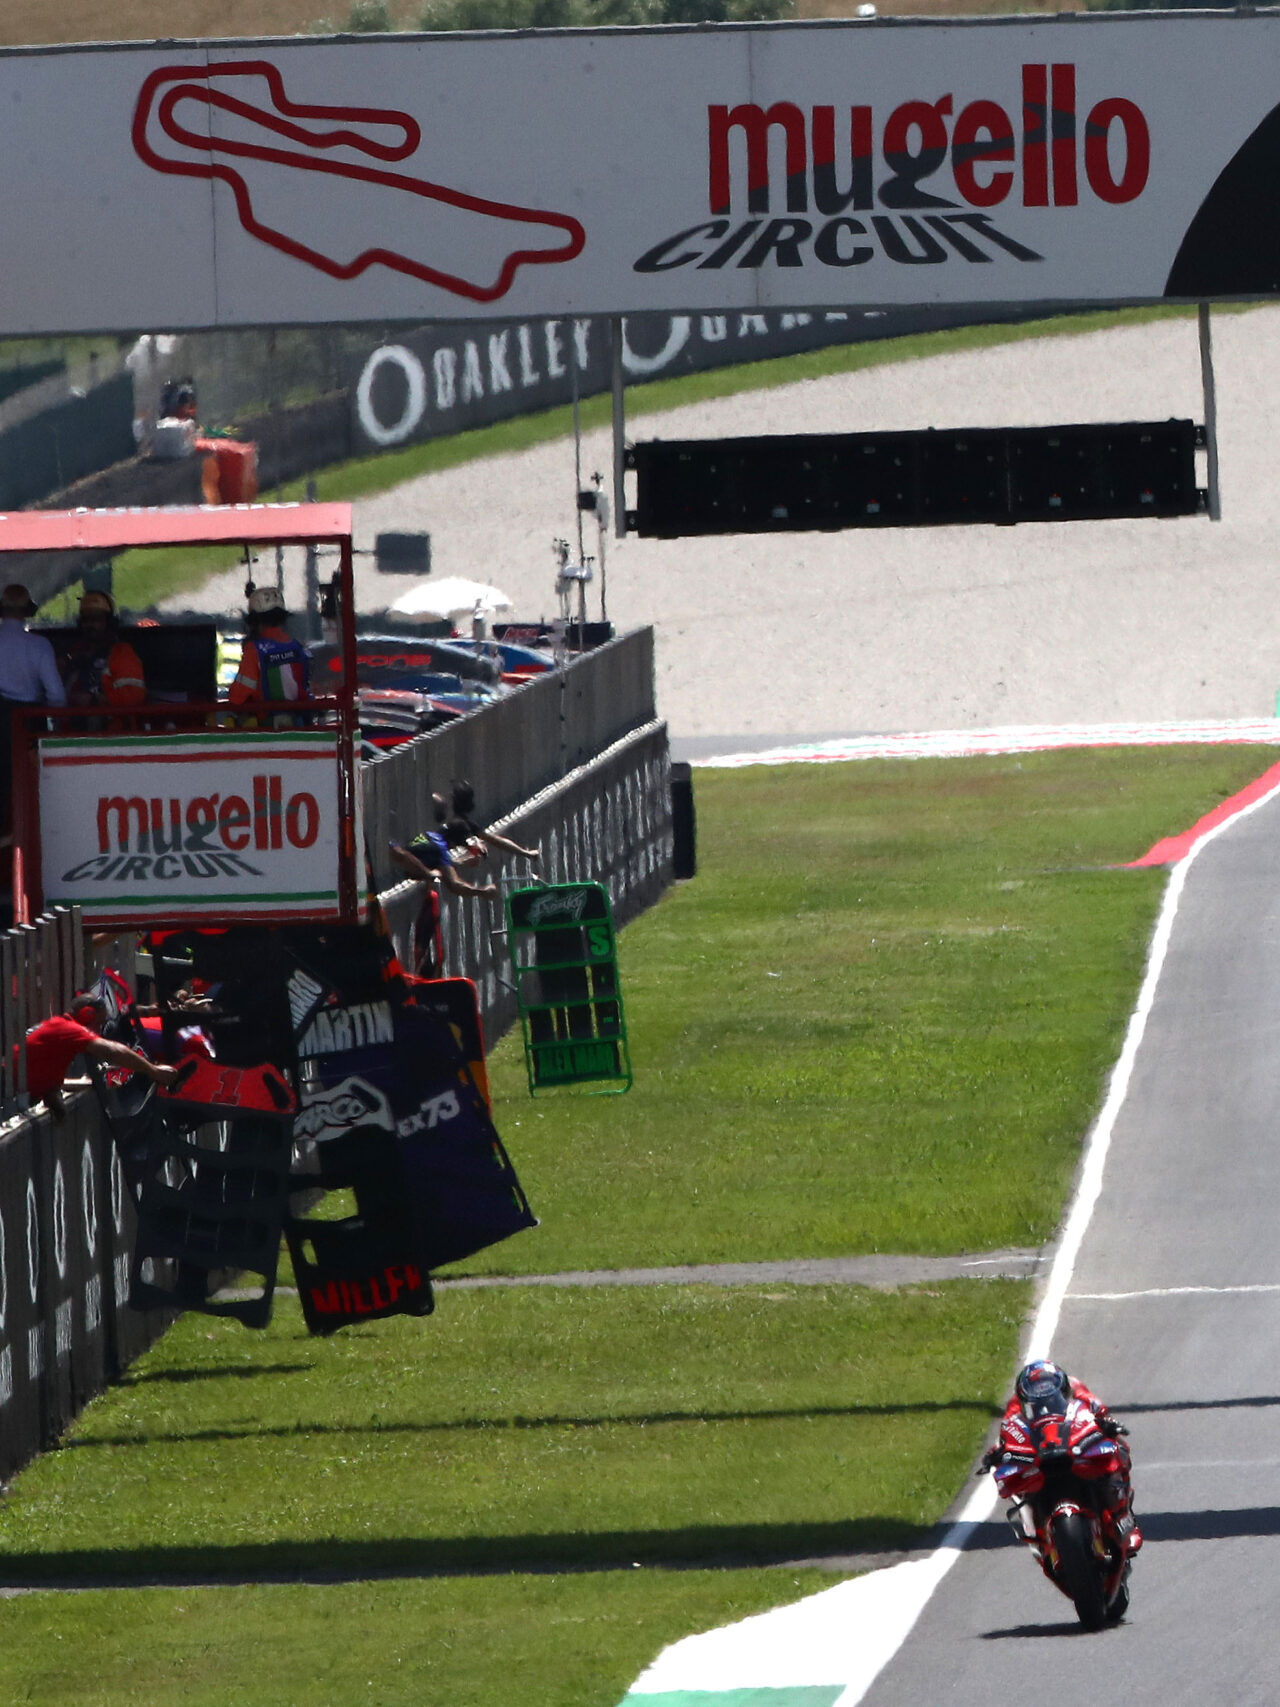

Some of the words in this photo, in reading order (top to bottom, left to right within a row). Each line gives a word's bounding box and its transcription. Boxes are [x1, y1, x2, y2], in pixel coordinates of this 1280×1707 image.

[707, 63, 1150, 216] mugello
[632, 212, 1046, 273] CIRCUIT
[432, 319, 592, 410] OAKLEY
[96, 774, 320, 854] mugello
[60, 851, 265, 882] CIRCUIT
[297, 999, 395, 1058] MARTIN
